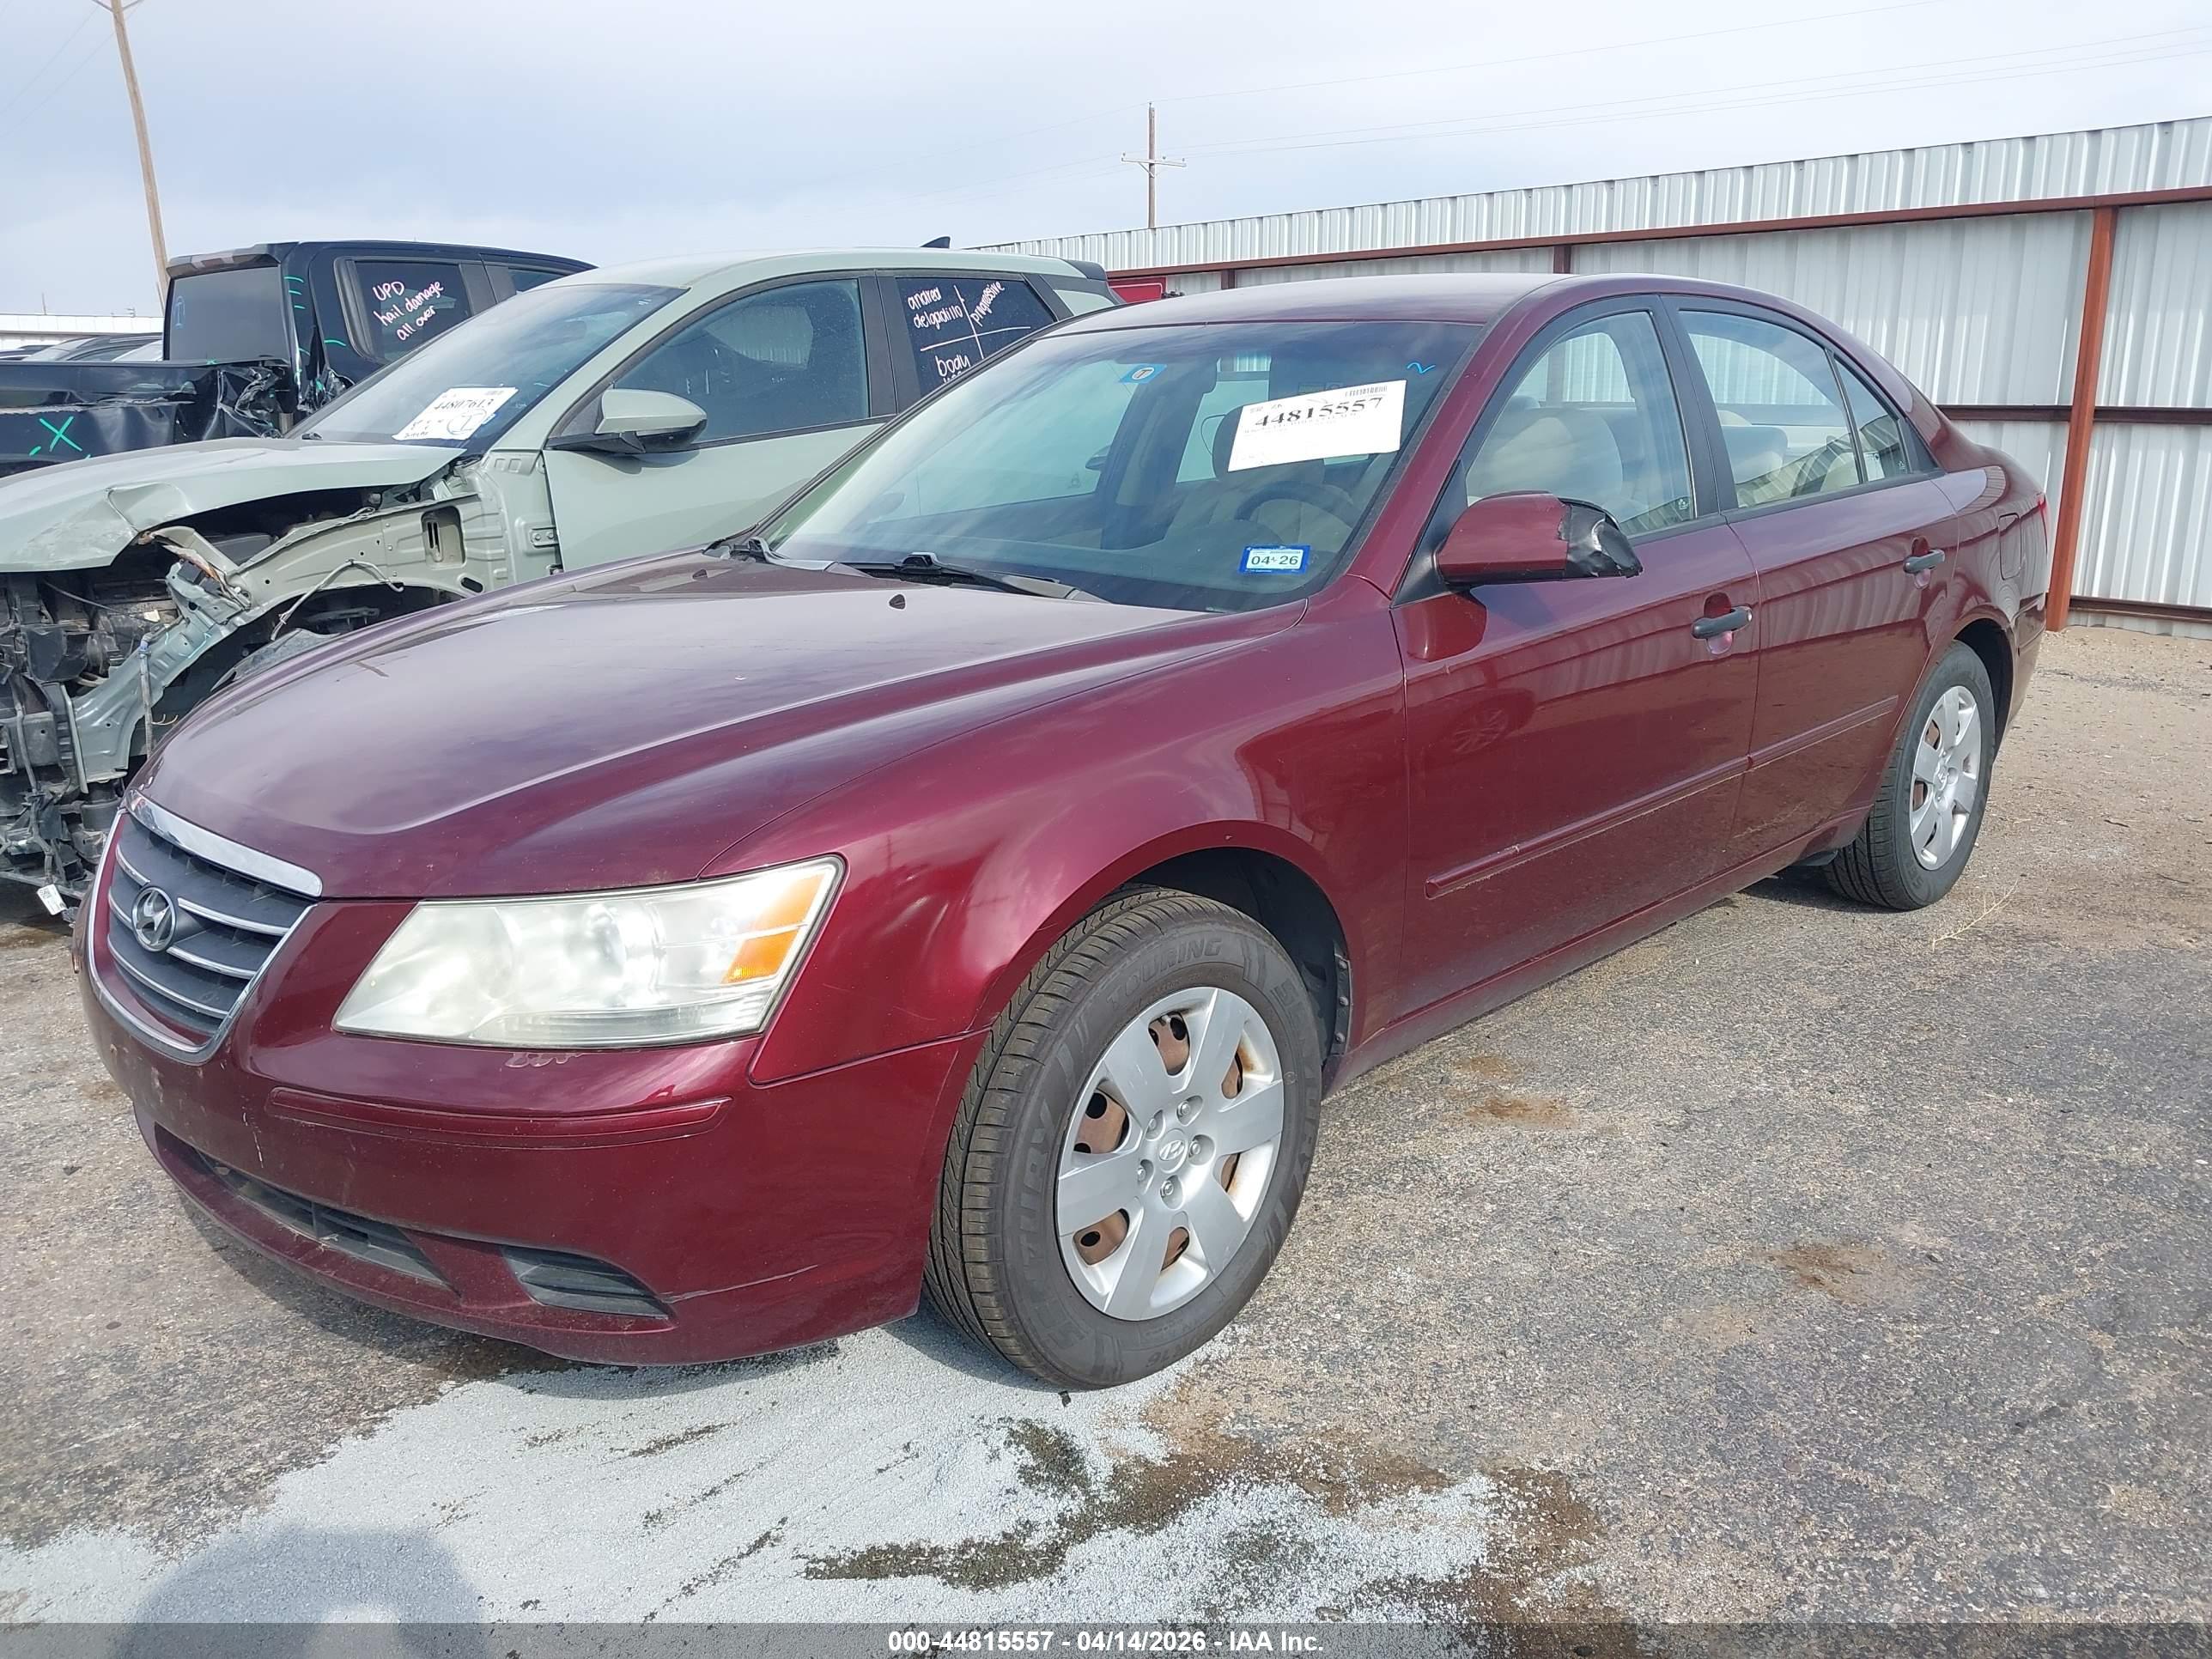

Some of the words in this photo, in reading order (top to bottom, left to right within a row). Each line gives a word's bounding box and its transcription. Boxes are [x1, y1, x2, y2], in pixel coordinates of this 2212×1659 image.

[372, 281, 405, 301] UPD
[373, 304, 404, 326] hail
[404, 281, 444, 313] damage
[908, 287, 942, 310] andrea
[969, 281, 1005, 327] progressive
[396, 322, 416, 341] all
[416, 305, 436, 327] over
[913, 305, 963, 330] delgadillo
[934, 354, 971, 377] body
[1255, 397, 1383, 427] 44815557
[1250, 556, 1271, 565] 04
[1279, 556, 1299, 565] 26
